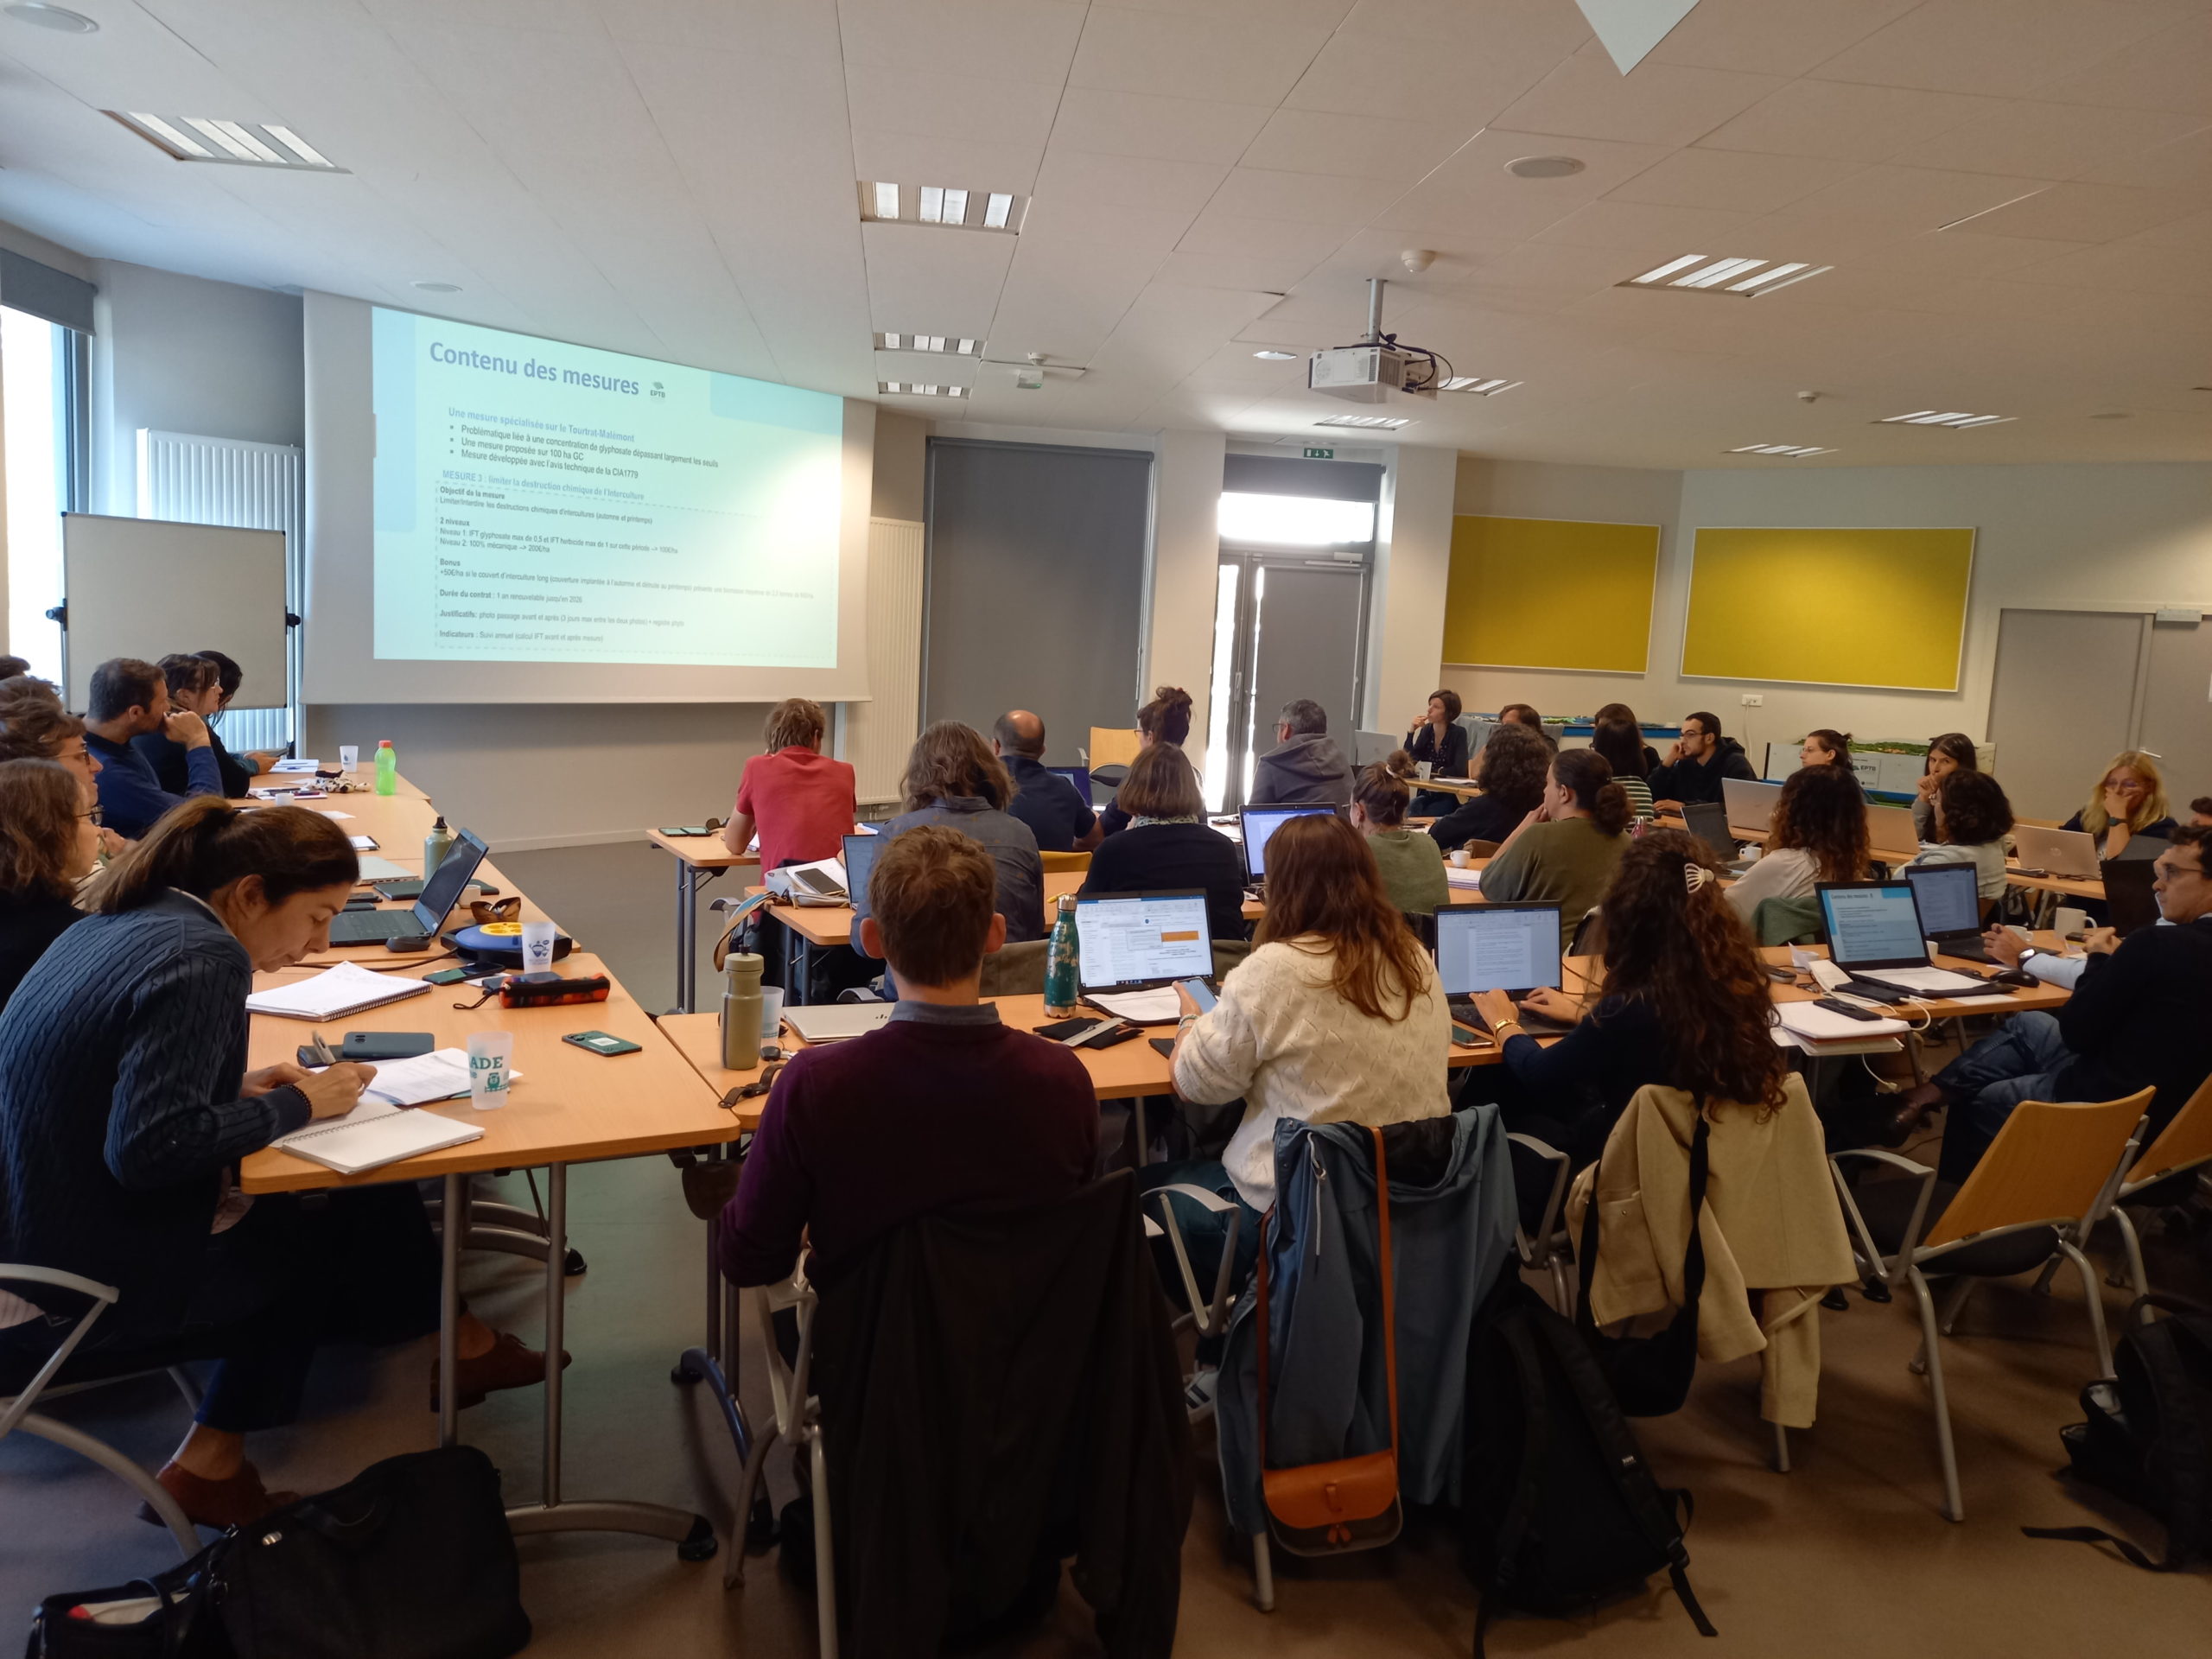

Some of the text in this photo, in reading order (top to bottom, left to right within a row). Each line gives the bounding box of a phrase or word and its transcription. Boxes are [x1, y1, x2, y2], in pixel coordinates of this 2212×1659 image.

[430, 342, 639, 395] Contenu des mesures
[448, 407, 466, 418] Une
[467, 411, 499, 423] mesure
[500, 415, 544, 429] spécialisée
[545, 423, 558, 431] sur
[559, 423, 567, 432] le
[461, 424, 512, 441] Problématique
[525, 433, 531, 442] à
[531, 435, 545, 444] une
[545, 436, 589, 451] concentration
[589, 442, 598, 451] de
[599, 444, 632, 457] glyphosate
[632, 448, 664, 461] dépassant
[664, 454, 692, 464] largement
[461, 437, 476, 447] Une
[477, 441, 504, 451] mesure
[505, 444, 537, 456] proposée
[550, 448, 562, 459] 100
[563, 450, 571, 460] ha
[573, 452, 584, 461] GC
[461, 448, 488, 461] Mesure
[489, 452, 529, 467] développée
[529, 458, 545, 467] avec
[563, 461, 594, 474] technique
[595, 465, 604, 474] de
[605, 467, 612, 475] la
[612, 467, 639, 479] CIA1779
[442, 469, 476, 482] MESURE
[488, 475, 512, 486] limiter
[512, 476, 520, 486] la
[520, 478, 561, 492] destruction
[562, 483, 593, 495] chimique
[594, 485, 603, 495] de
[440, 486, 465, 497] Objectif
[486, 500, 495, 509] les
[496, 502, 530, 512] destructions
[531, 505, 558, 516] chimiques
[445, 518, 470, 526] niveaux
[440, 528, 461, 537] Niveau
[480, 531, 511, 541] glyphosate
[525, 534, 532, 543] de
[440, 537, 461, 546] Niveau
[469, 540, 486, 549] 100%
[440, 558, 461, 567] Bonus
[537, 575, 549, 583] long
[440, 589, 459, 598] Durée
[460, 589, 468, 598] du
[440, 630, 474, 639] Indicateurs
